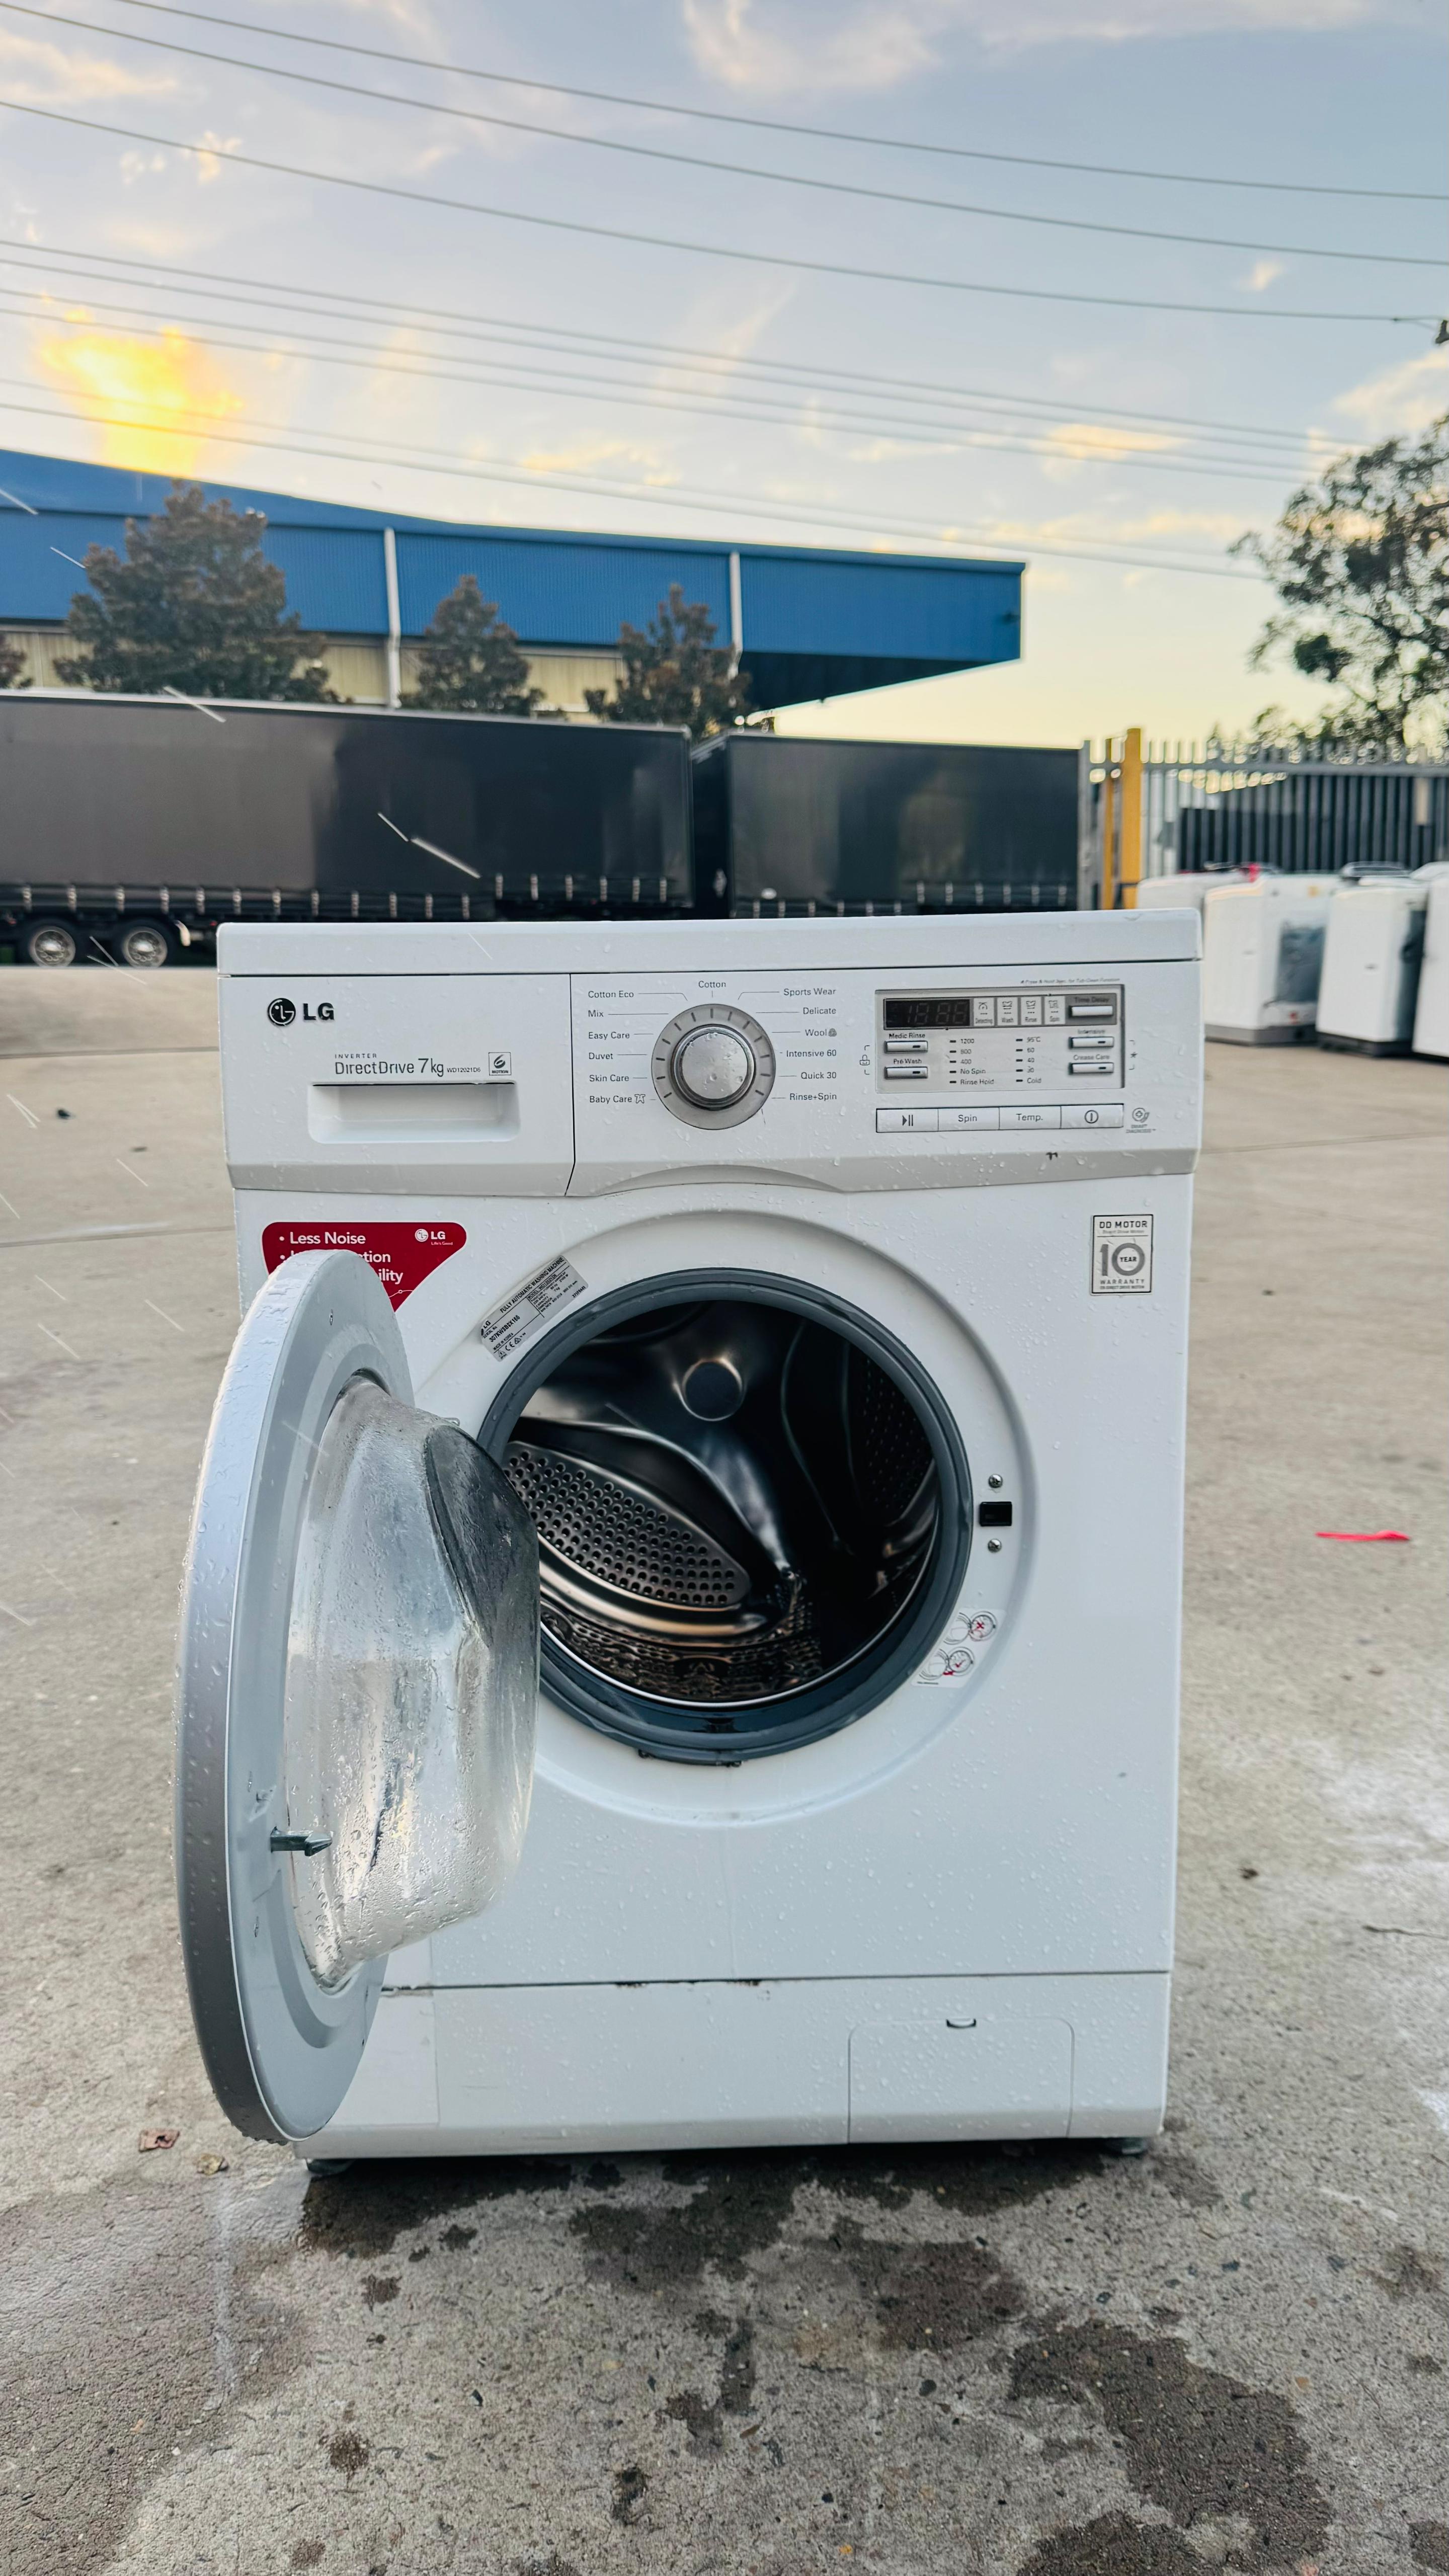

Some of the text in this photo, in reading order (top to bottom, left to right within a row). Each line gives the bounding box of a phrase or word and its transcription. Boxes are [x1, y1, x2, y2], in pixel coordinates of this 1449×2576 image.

[783, 988, 811, 997] Sports
[303, 1002, 335, 1020] LG
[589, 1032, 608, 1040] Easy
[805, 1028, 827, 1036] Wool
[590, 1096, 610, 1104] Baby
[790, 1093, 837, 1101] Rinse+Spin
[958, 1114, 978, 1123] Spin
[1016, 1113, 1043, 1122] Temp.
[290, 1232, 366, 1244] Less Noise
[431, 1231, 446, 1240] LG
[499, 1301, 513, 1314] FULLY
[510, 1283, 533, 1304] AUTOMATIC
[530, 1269, 549, 1286] WASHING
[546, 1256, 564, 1272] MACHINE
[482, 1320, 491, 1329] LG
